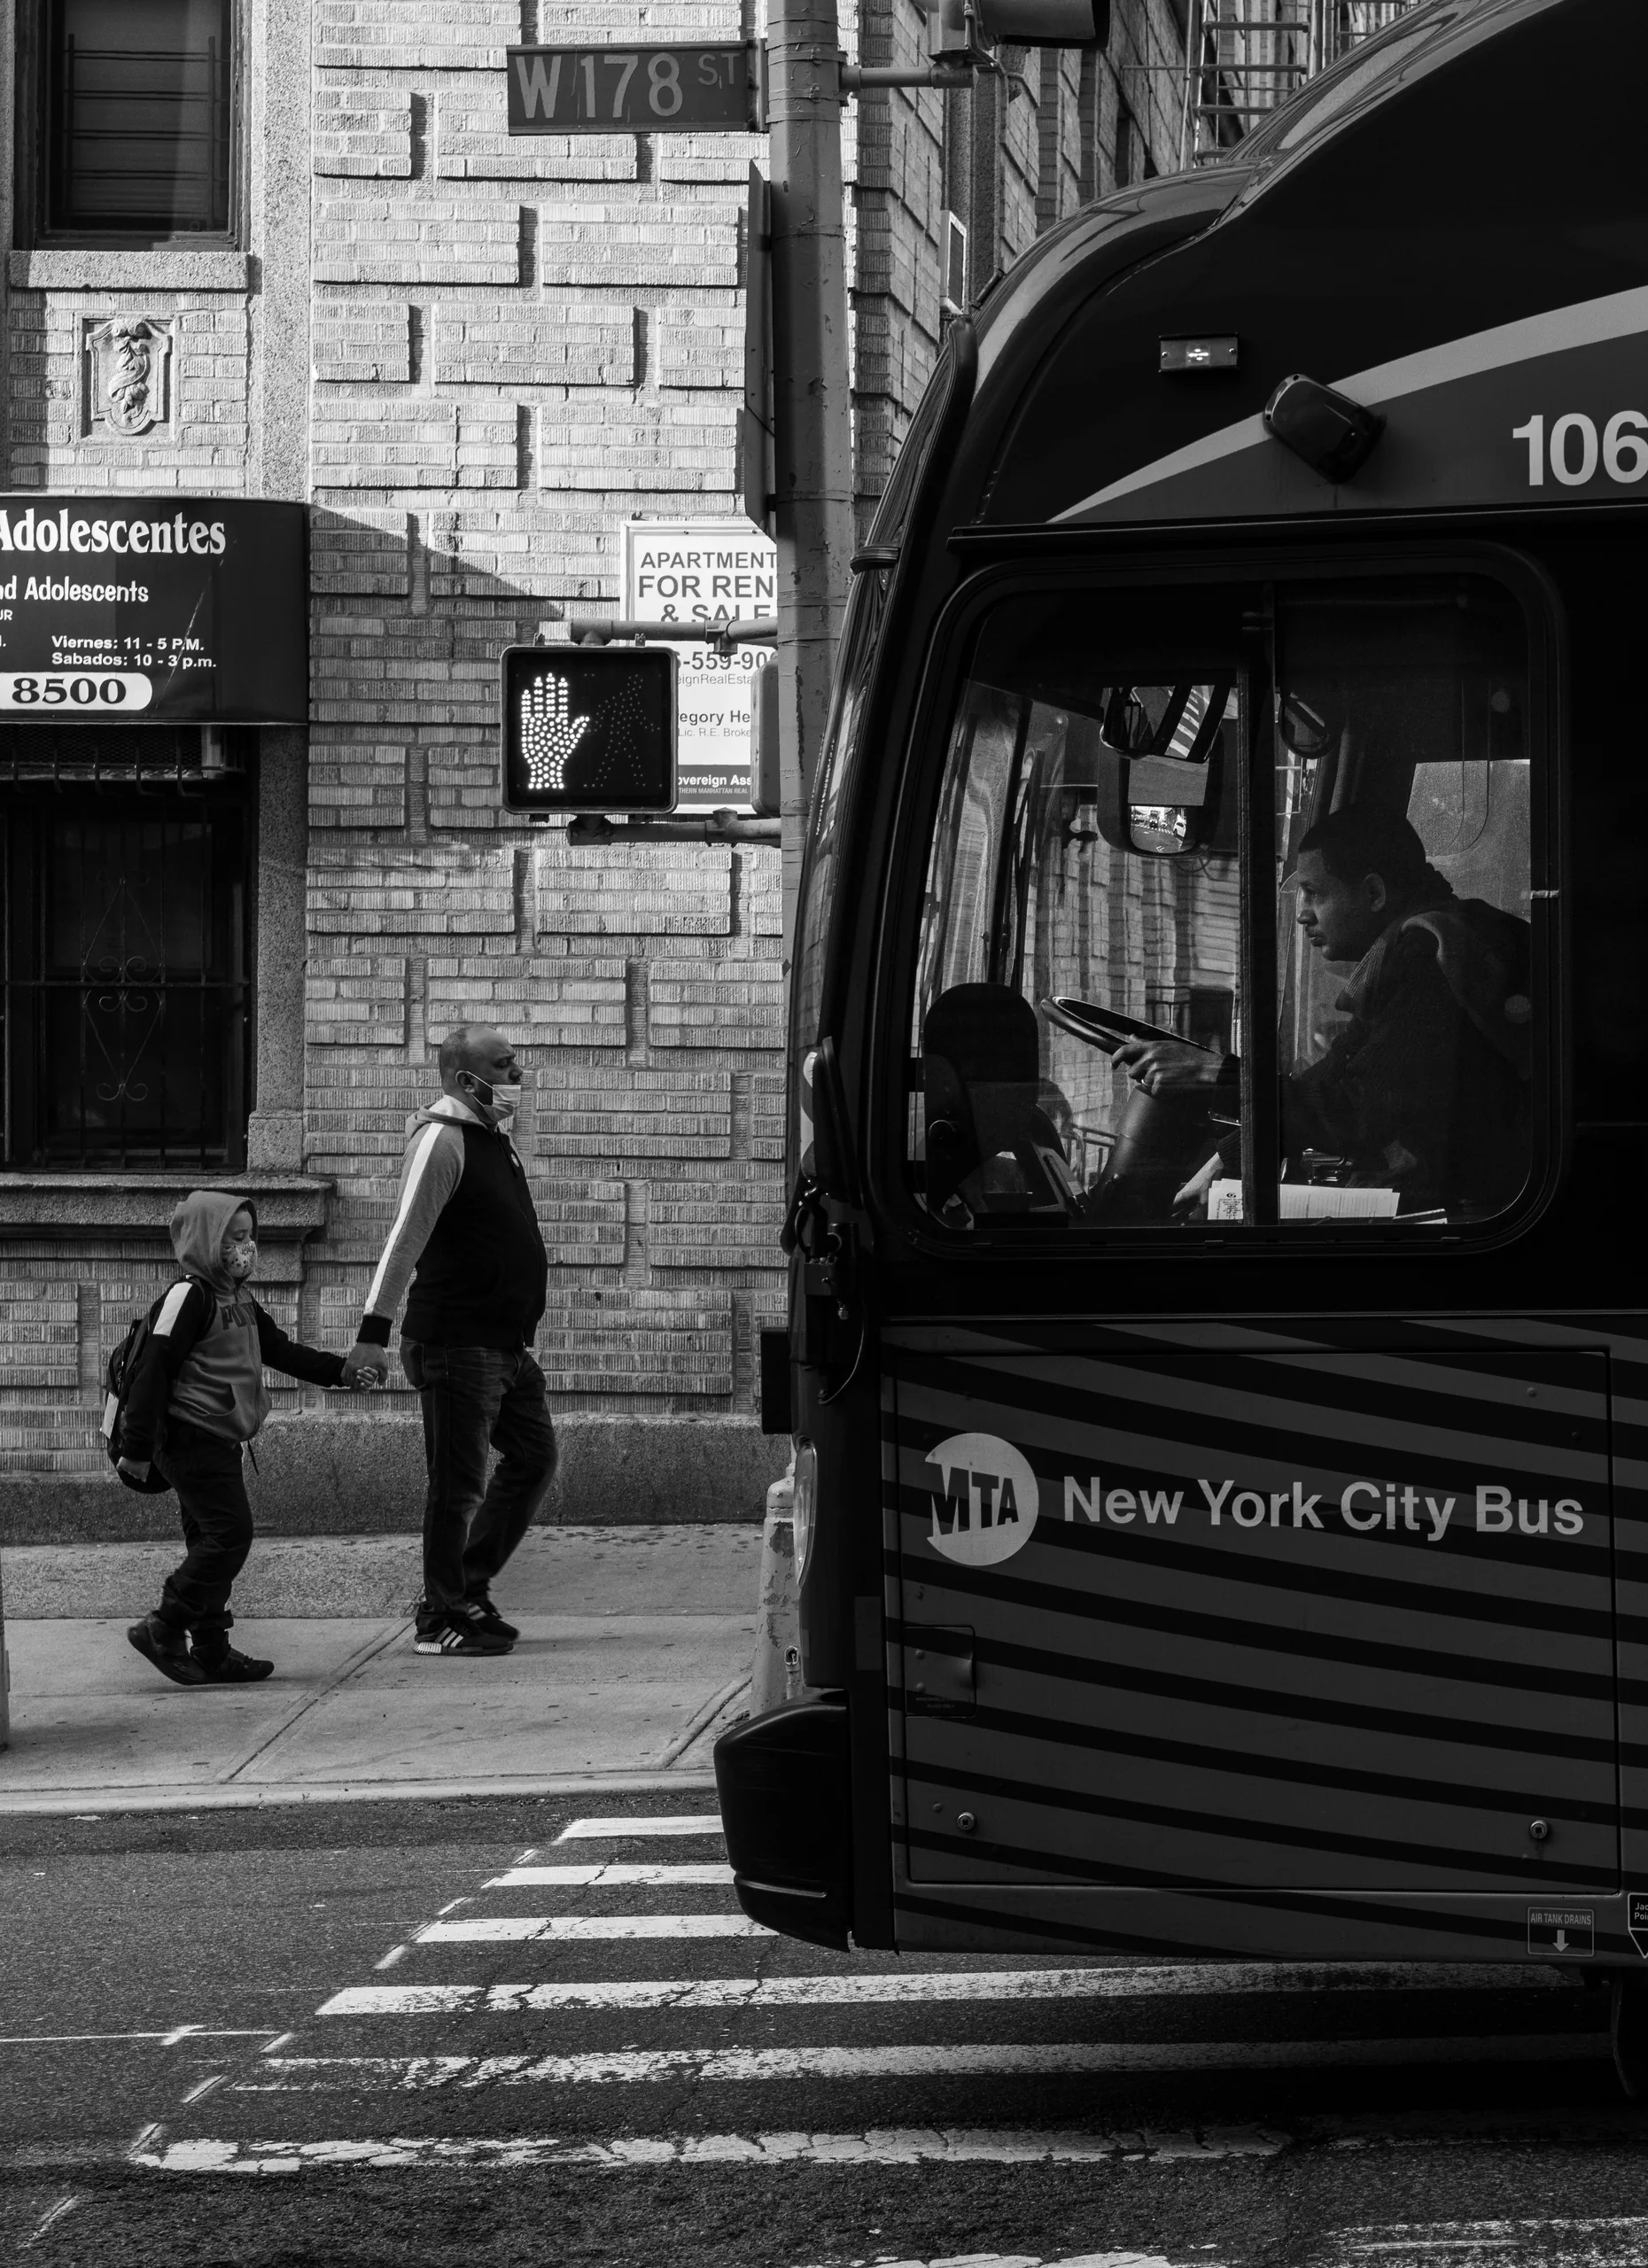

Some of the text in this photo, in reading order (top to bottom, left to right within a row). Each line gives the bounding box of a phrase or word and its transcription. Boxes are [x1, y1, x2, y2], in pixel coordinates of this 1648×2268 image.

[516, 52, 741, 118] W 178 ST
[1512, 410, 1648, 486] 106
[0, 508, 226, 554] Adolescentes
[640, 552, 776, 569] APARTMENT
[0, 575, 149, 602] d Adolescents
[639, 575, 773, 598] FOR REN
[51, 635, 118, 649] Viernes:
[124, 637, 140, 649] 11
[157, 637, 167, 649] 5
[172, 638, 205, 650] P.M.
[51, 652, 128, 666] Sabados:
[134, 654, 152, 666] 10
[167, 655, 178, 667] 3
[182, 657, 217, 670] p.m.
[12, 678, 126, 704] 8500
[730, 710, 750, 723] He
[698, 727, 719, 737] R.E.
[925, 1462, 1019, 1537] MTA
[1064, 1476, 1584, 1542] New York City Bus
[1530, 1913, 1591, 1925] AIR TANK DRAINS
[1634, 1912, 1648, 1921] Poi
